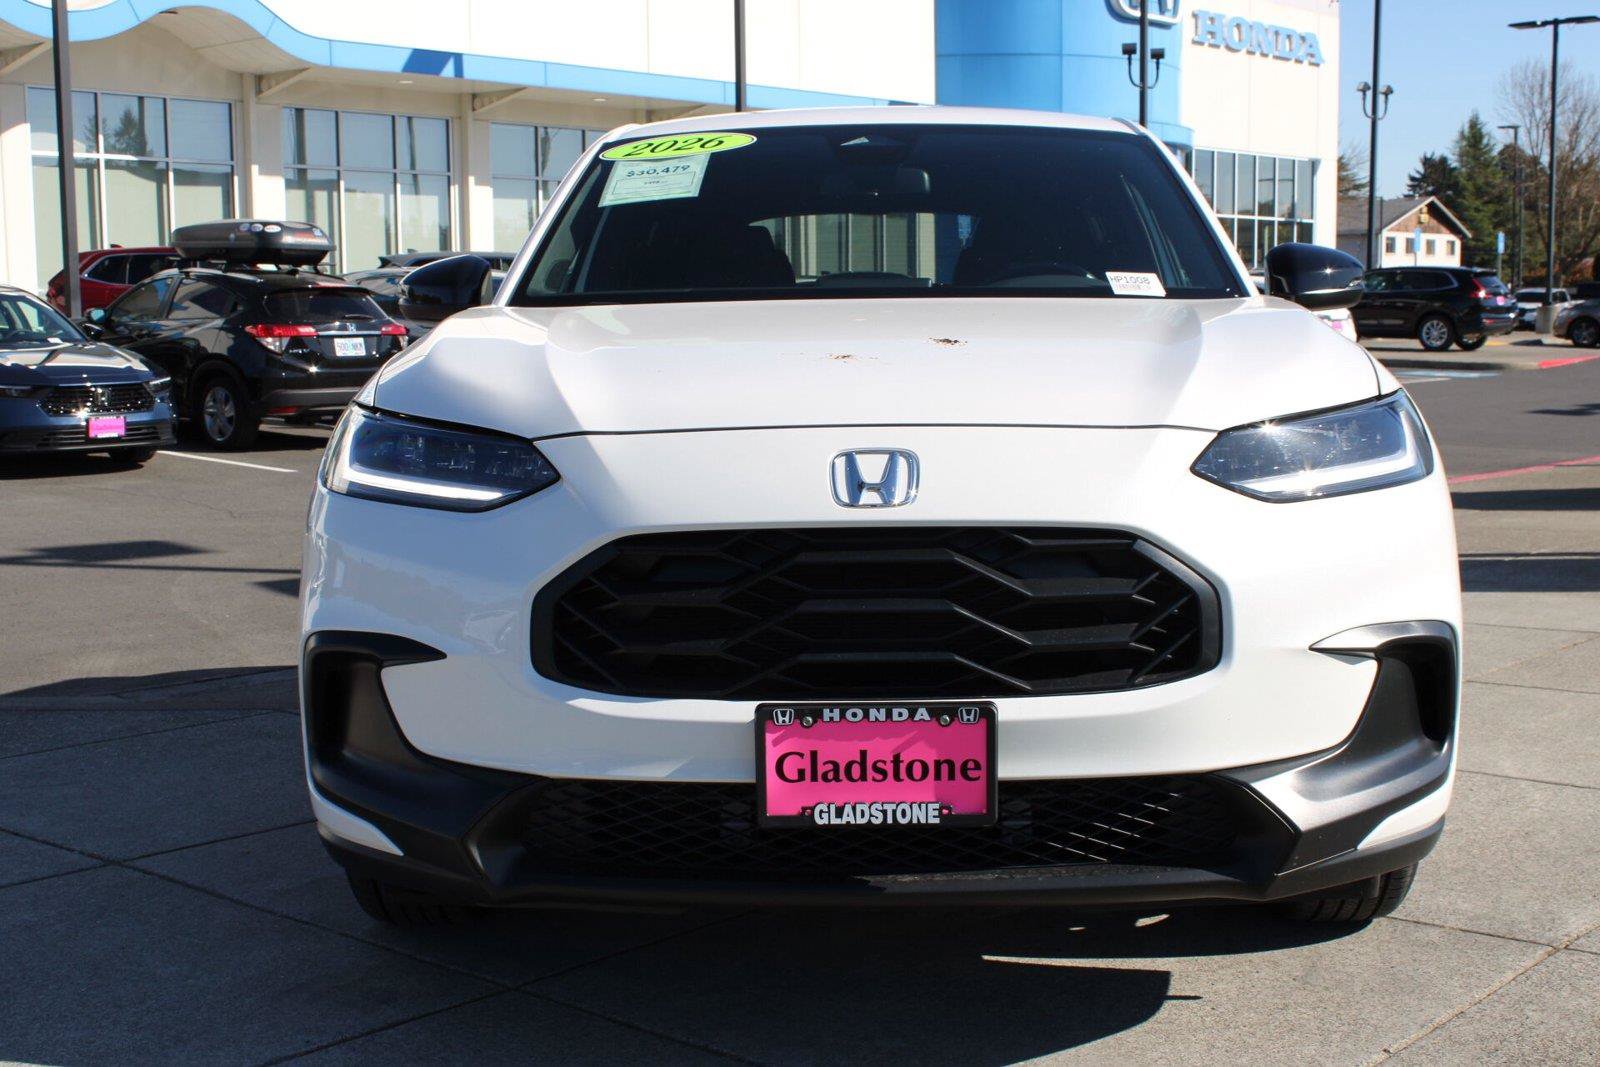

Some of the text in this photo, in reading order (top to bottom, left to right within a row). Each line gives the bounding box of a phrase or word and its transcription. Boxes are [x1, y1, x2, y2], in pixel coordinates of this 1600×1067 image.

[1192, 9, 1324, 67] HONDA
[622, 135, 733, 158] 2026
[822, 707, 931, 722] HONDA
[774, 749, 982, 784] Gladstone
[813, 803, 941, 825] GLADSTONE
